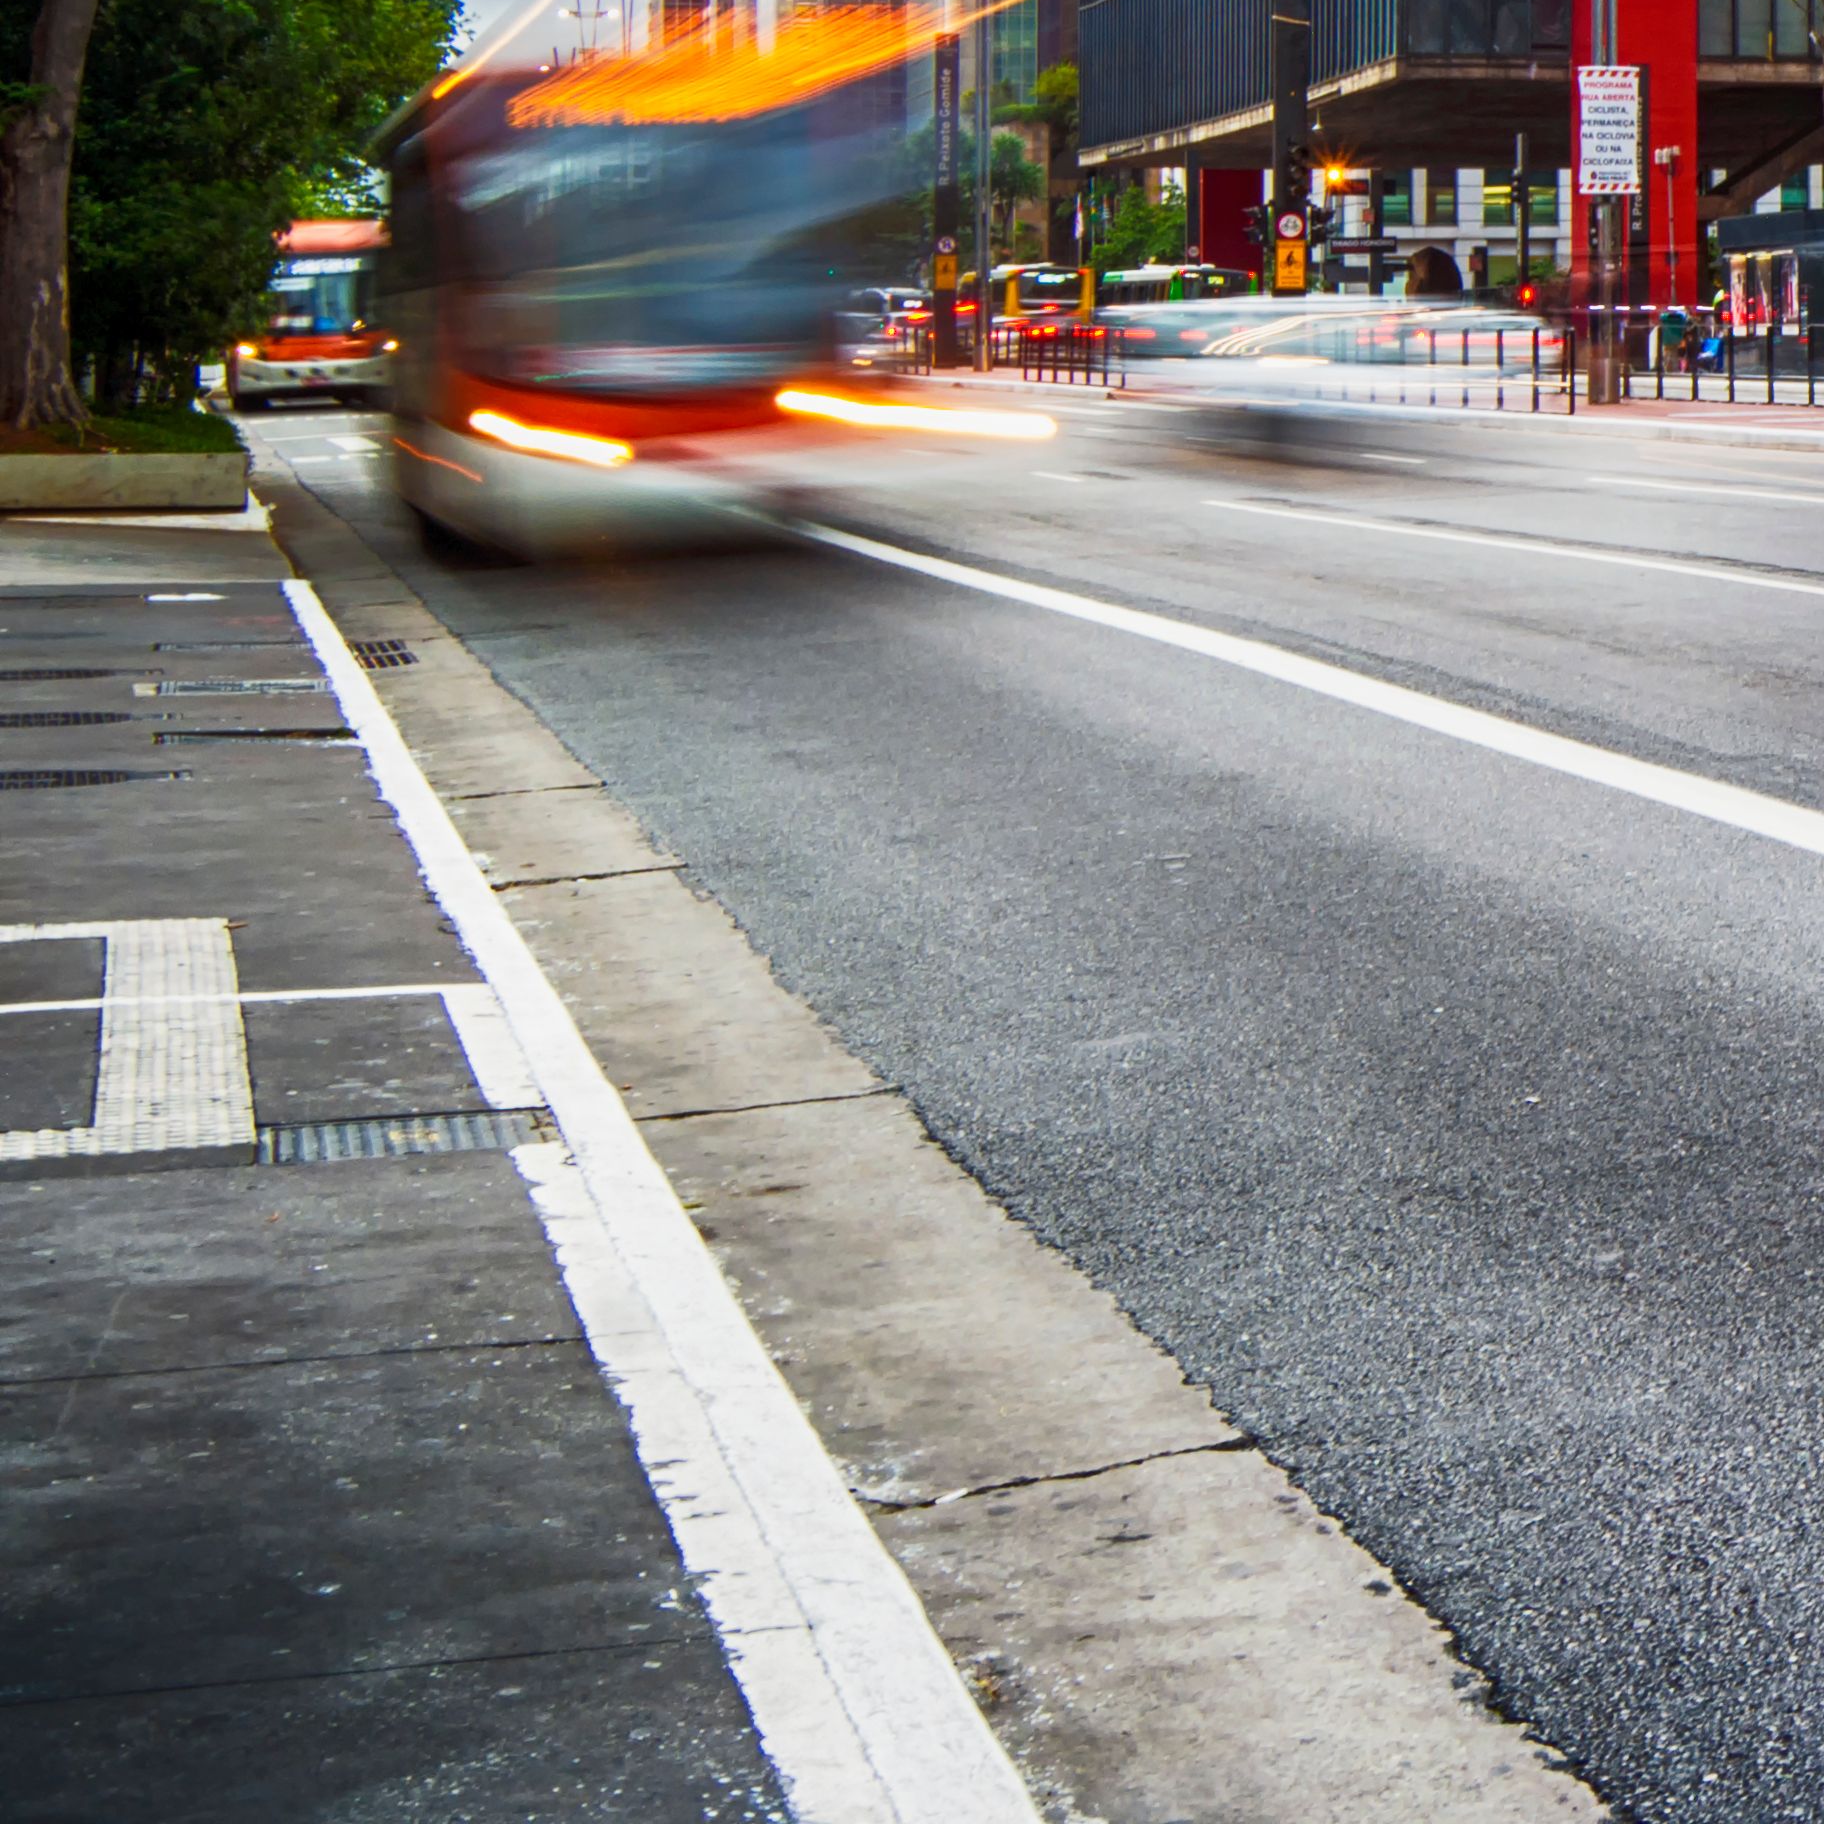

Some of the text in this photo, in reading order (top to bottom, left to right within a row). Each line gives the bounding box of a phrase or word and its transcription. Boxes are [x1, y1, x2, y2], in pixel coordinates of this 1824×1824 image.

[939, 68, 951, 117] Gomide
[1582, 120, 1635, 128] PERMANEÇA
[938, 121, 950, 170] Peixoto
[1595, 145, 1608, 153] OU
[1583, 158, 1633, 166] CICLOFAIXA
